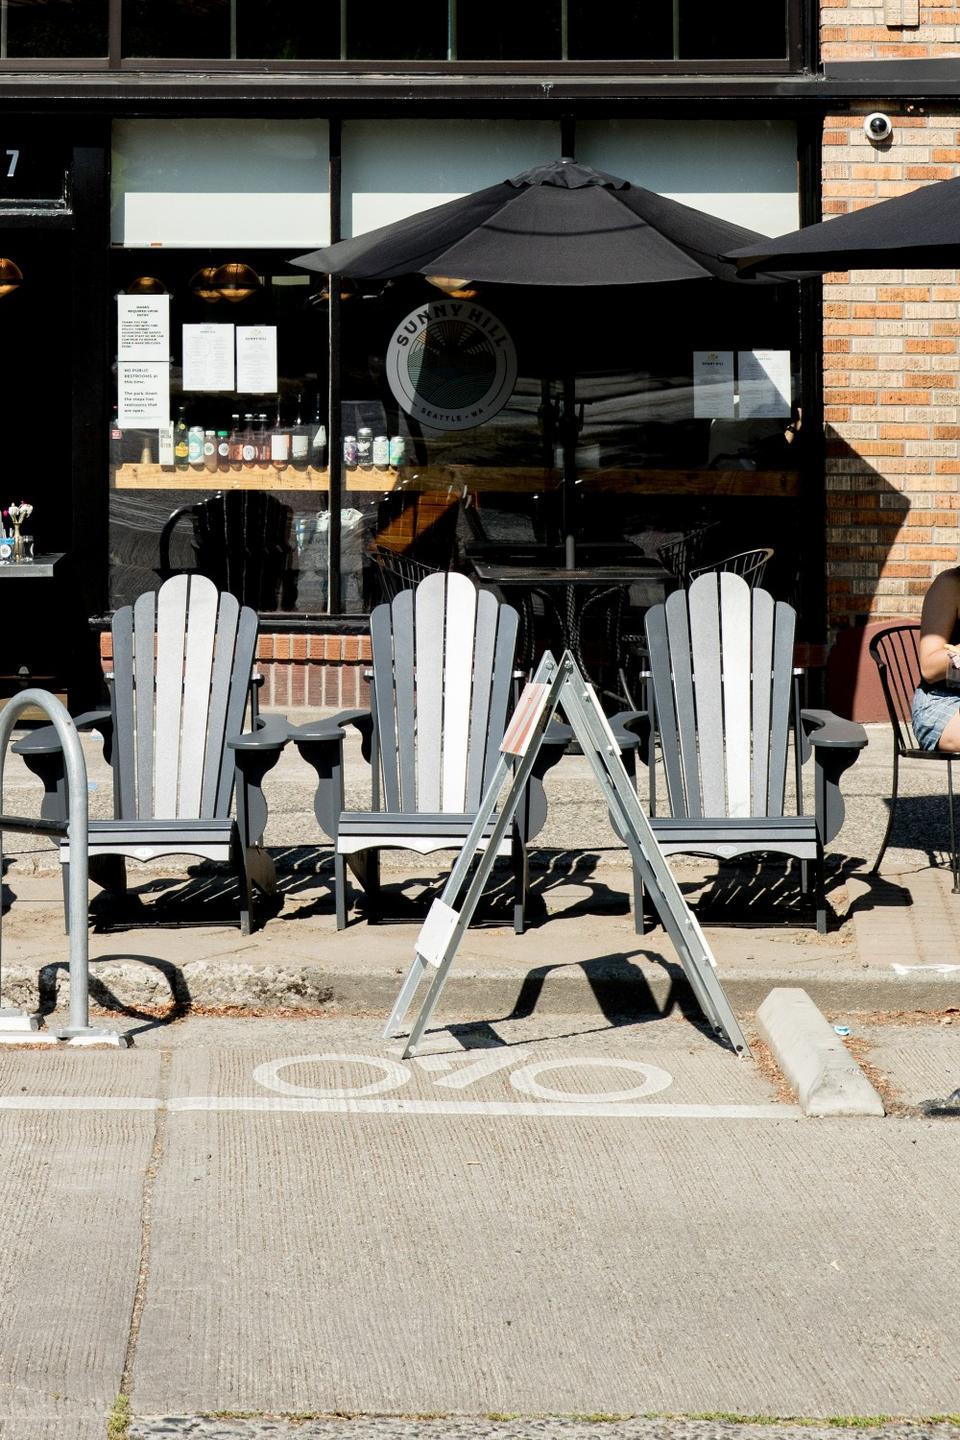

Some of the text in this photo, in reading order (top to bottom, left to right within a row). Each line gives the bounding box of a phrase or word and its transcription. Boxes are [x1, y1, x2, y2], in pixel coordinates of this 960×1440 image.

[397, 304, 506, 347] SUNNY HILL
[421, 408, 462, 422] SEATTLE
